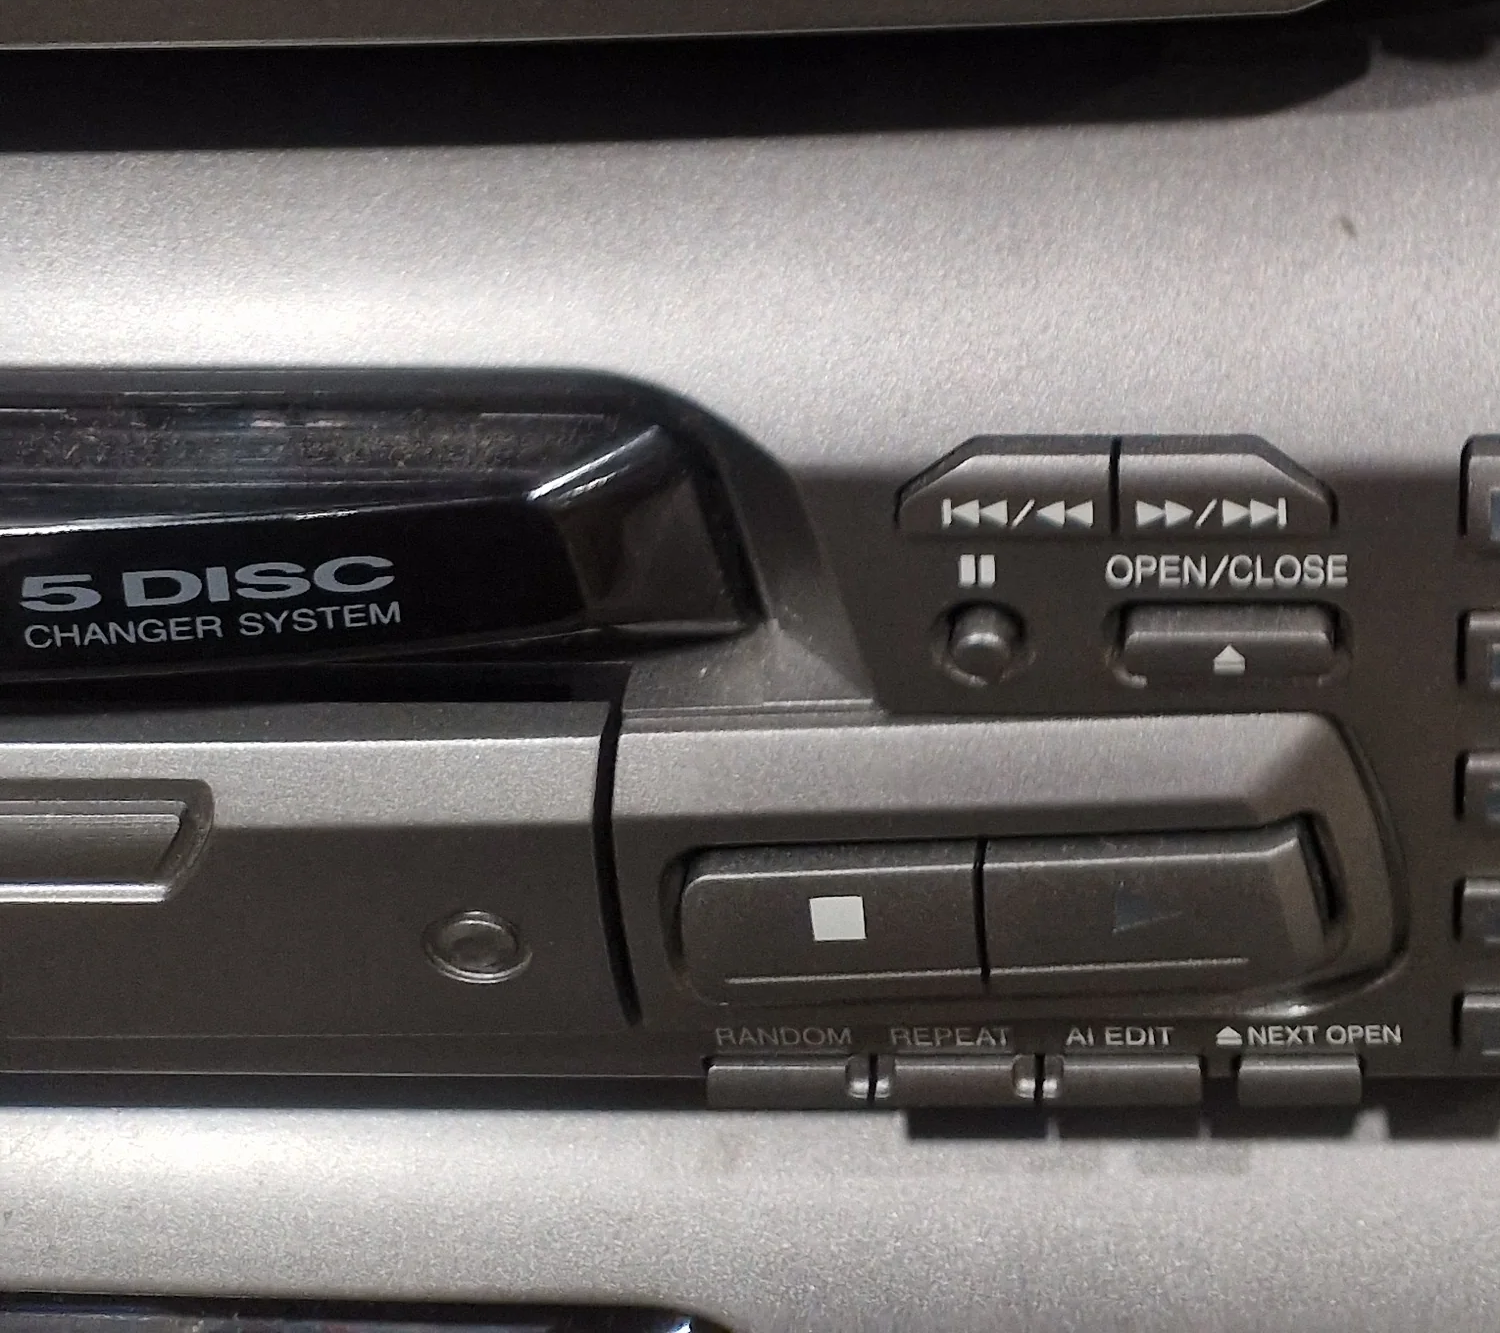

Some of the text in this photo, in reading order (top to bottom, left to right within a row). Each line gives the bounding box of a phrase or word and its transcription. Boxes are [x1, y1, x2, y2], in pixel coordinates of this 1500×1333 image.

[1103, 553, 1350, 589] OPEN/CLOSE
[20, 555, 395, 613] 5 DISC
[23, 599, 402, 650] CHANGER SYSTEM
[714, 1026, 854, 1048] RANDOM
[889, 1026, 1012, 1048] REPEAT
[1104, 1026, 1175, 1046] EDIT
[1246, 1025, 1402, 1046] NEXT OPEN
